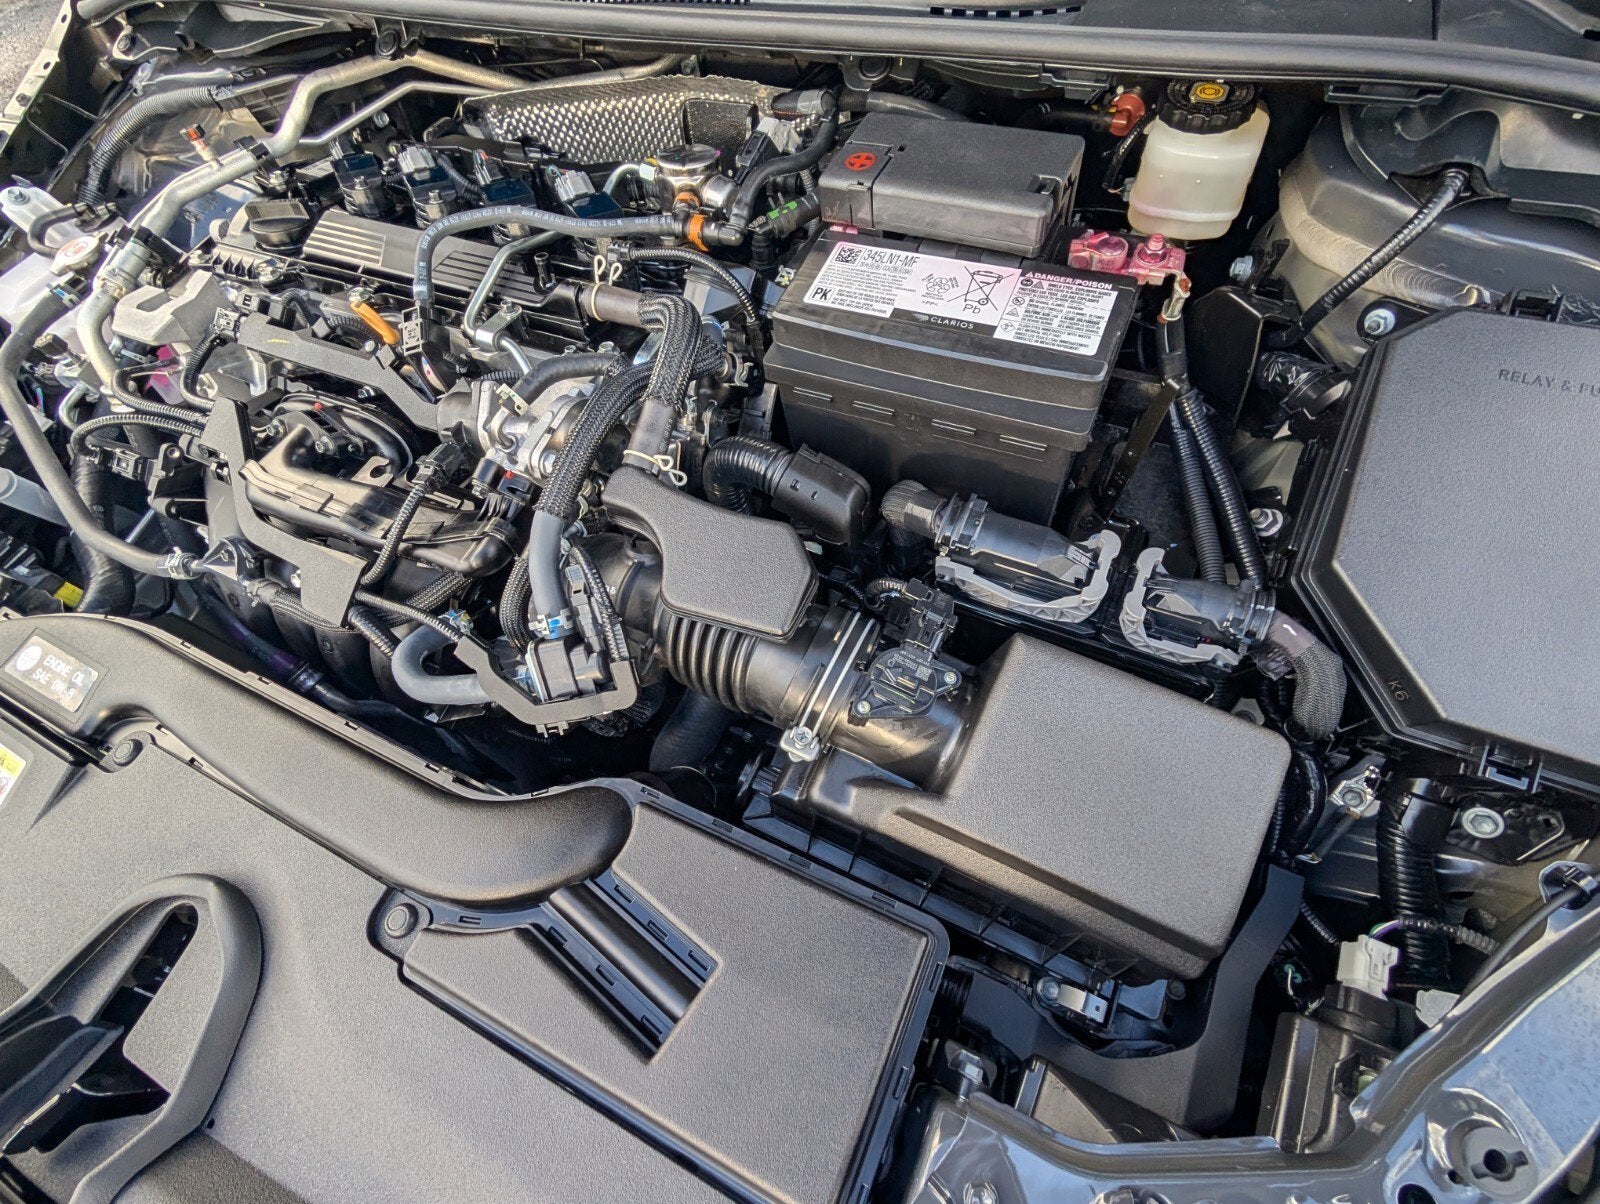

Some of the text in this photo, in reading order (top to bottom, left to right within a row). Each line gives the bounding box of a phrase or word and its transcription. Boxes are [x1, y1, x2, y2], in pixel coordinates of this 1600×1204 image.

[864, 250, 920, 267] 345LN1-MF
[1034, 272, 1112, 290] DANGER/POISON
[812, 287, 831, 300] PK
[963, 304, 981, 314] Pb
[930, 316, 974, 330] CLARIOS
[1498, 369, 1555, 388] RELAY
[1562, 380, 1571, 390] &
[43, 654, 86, 686] ENGINE OIL
[32, 668, 75, 698] SAE 0W-8
